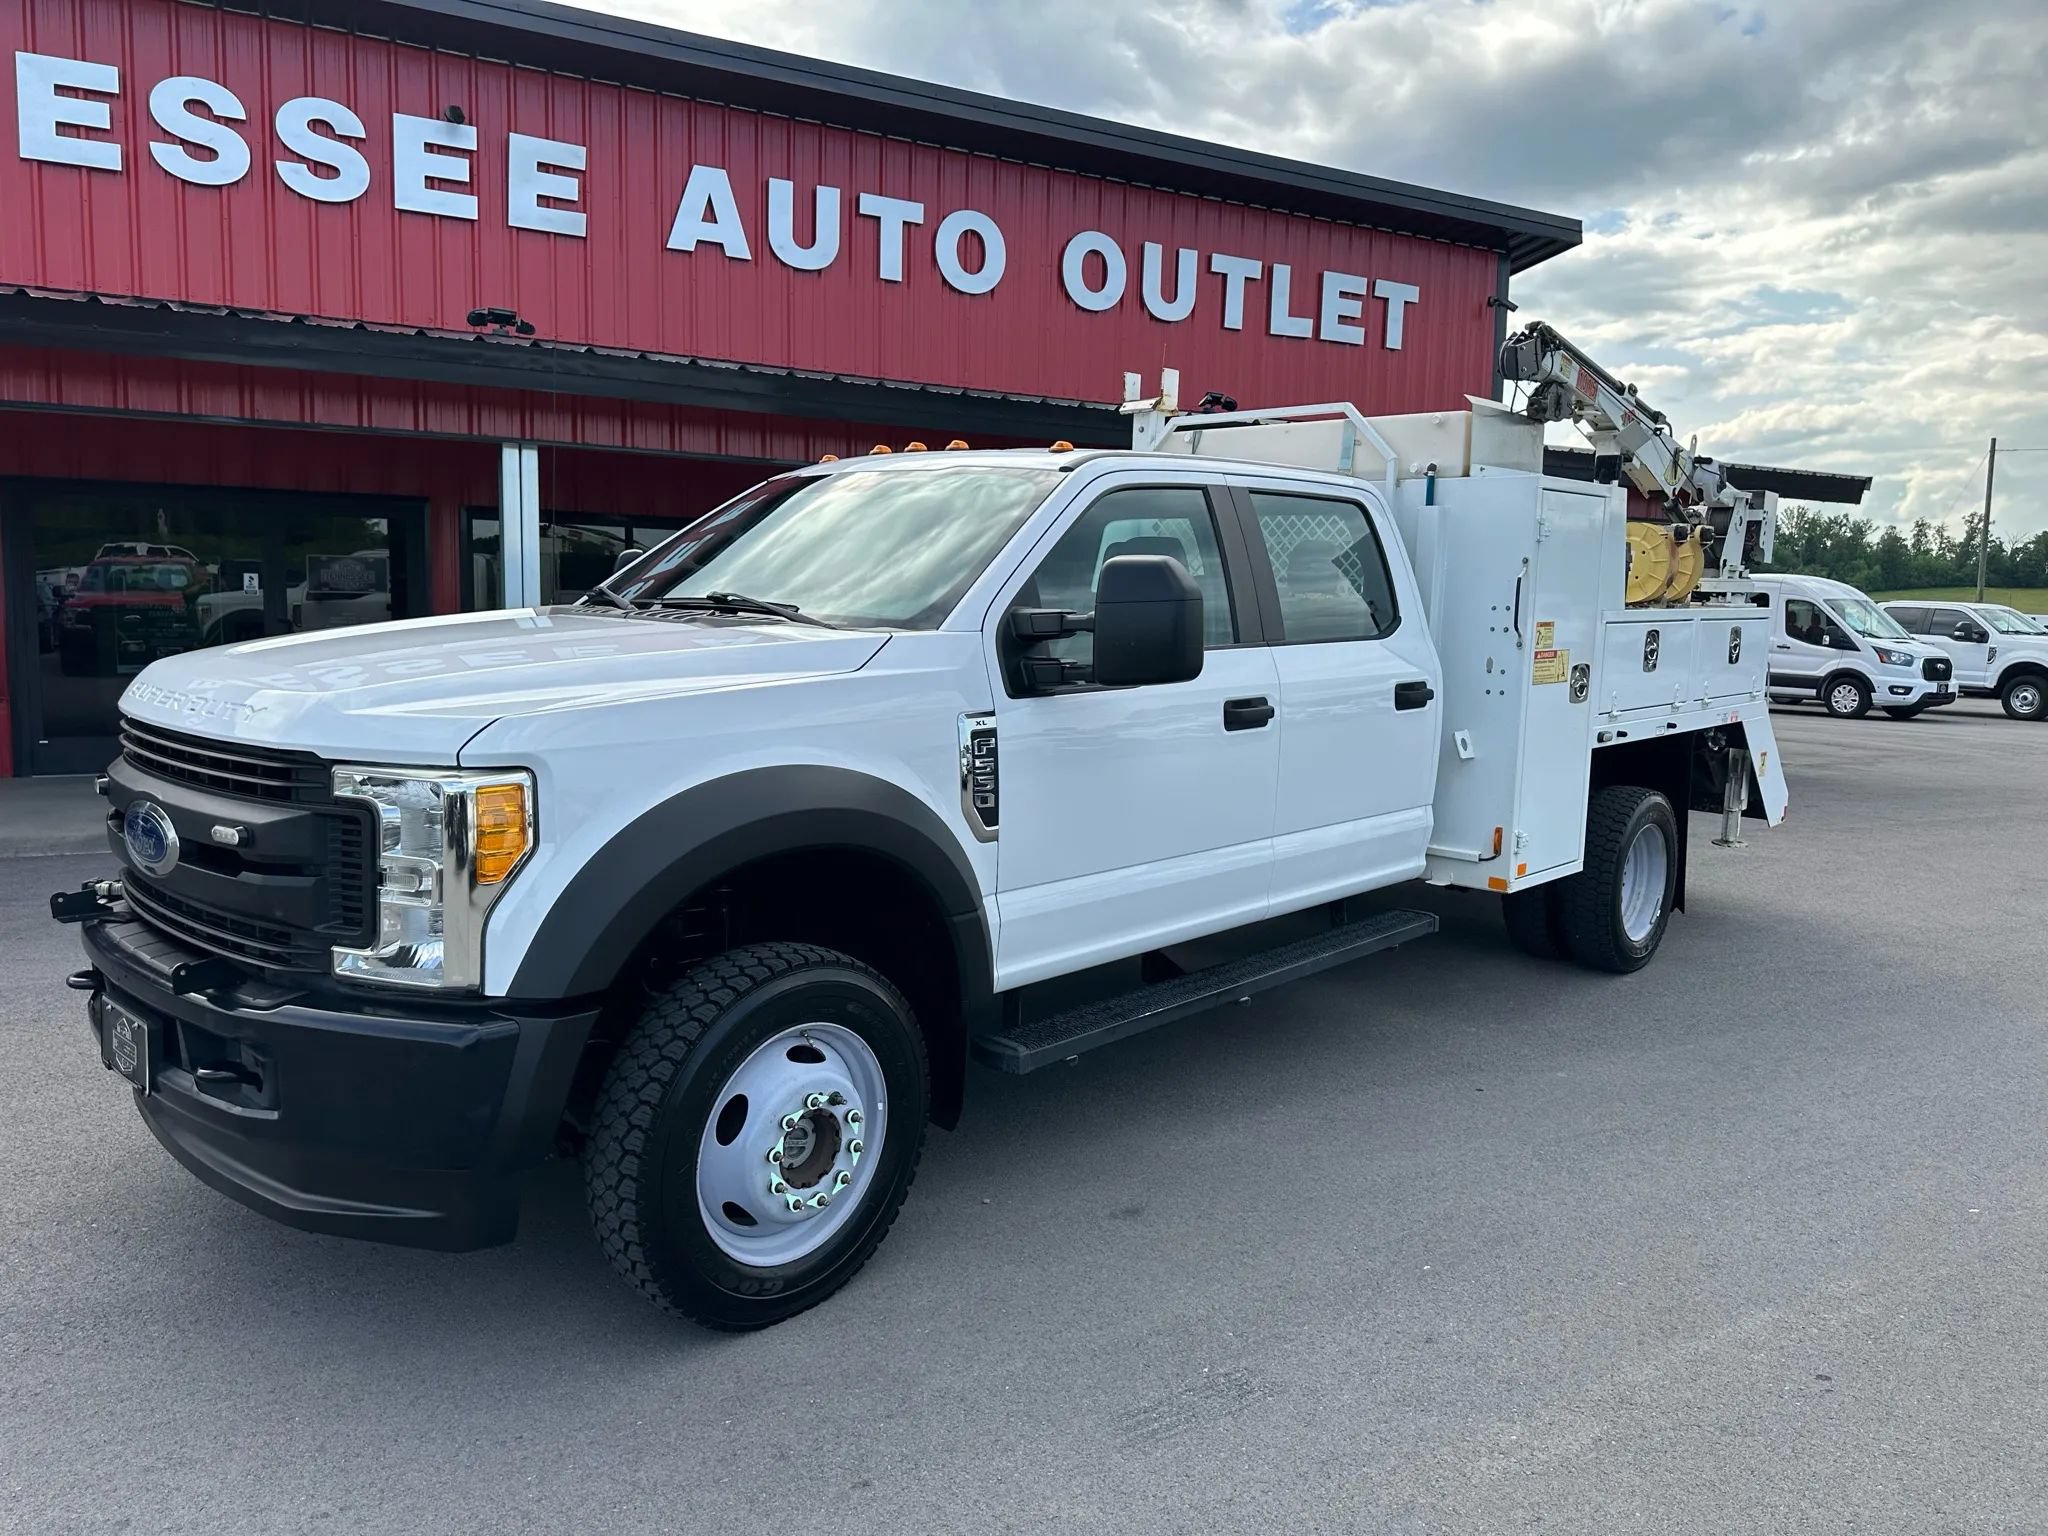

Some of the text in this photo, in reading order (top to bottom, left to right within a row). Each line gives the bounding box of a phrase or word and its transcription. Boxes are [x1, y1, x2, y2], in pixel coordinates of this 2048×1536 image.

[14, 50, 1420, 350] ESSEE AUTO OUTLET
[129, 681, 268, 723] SUPER DUTY
